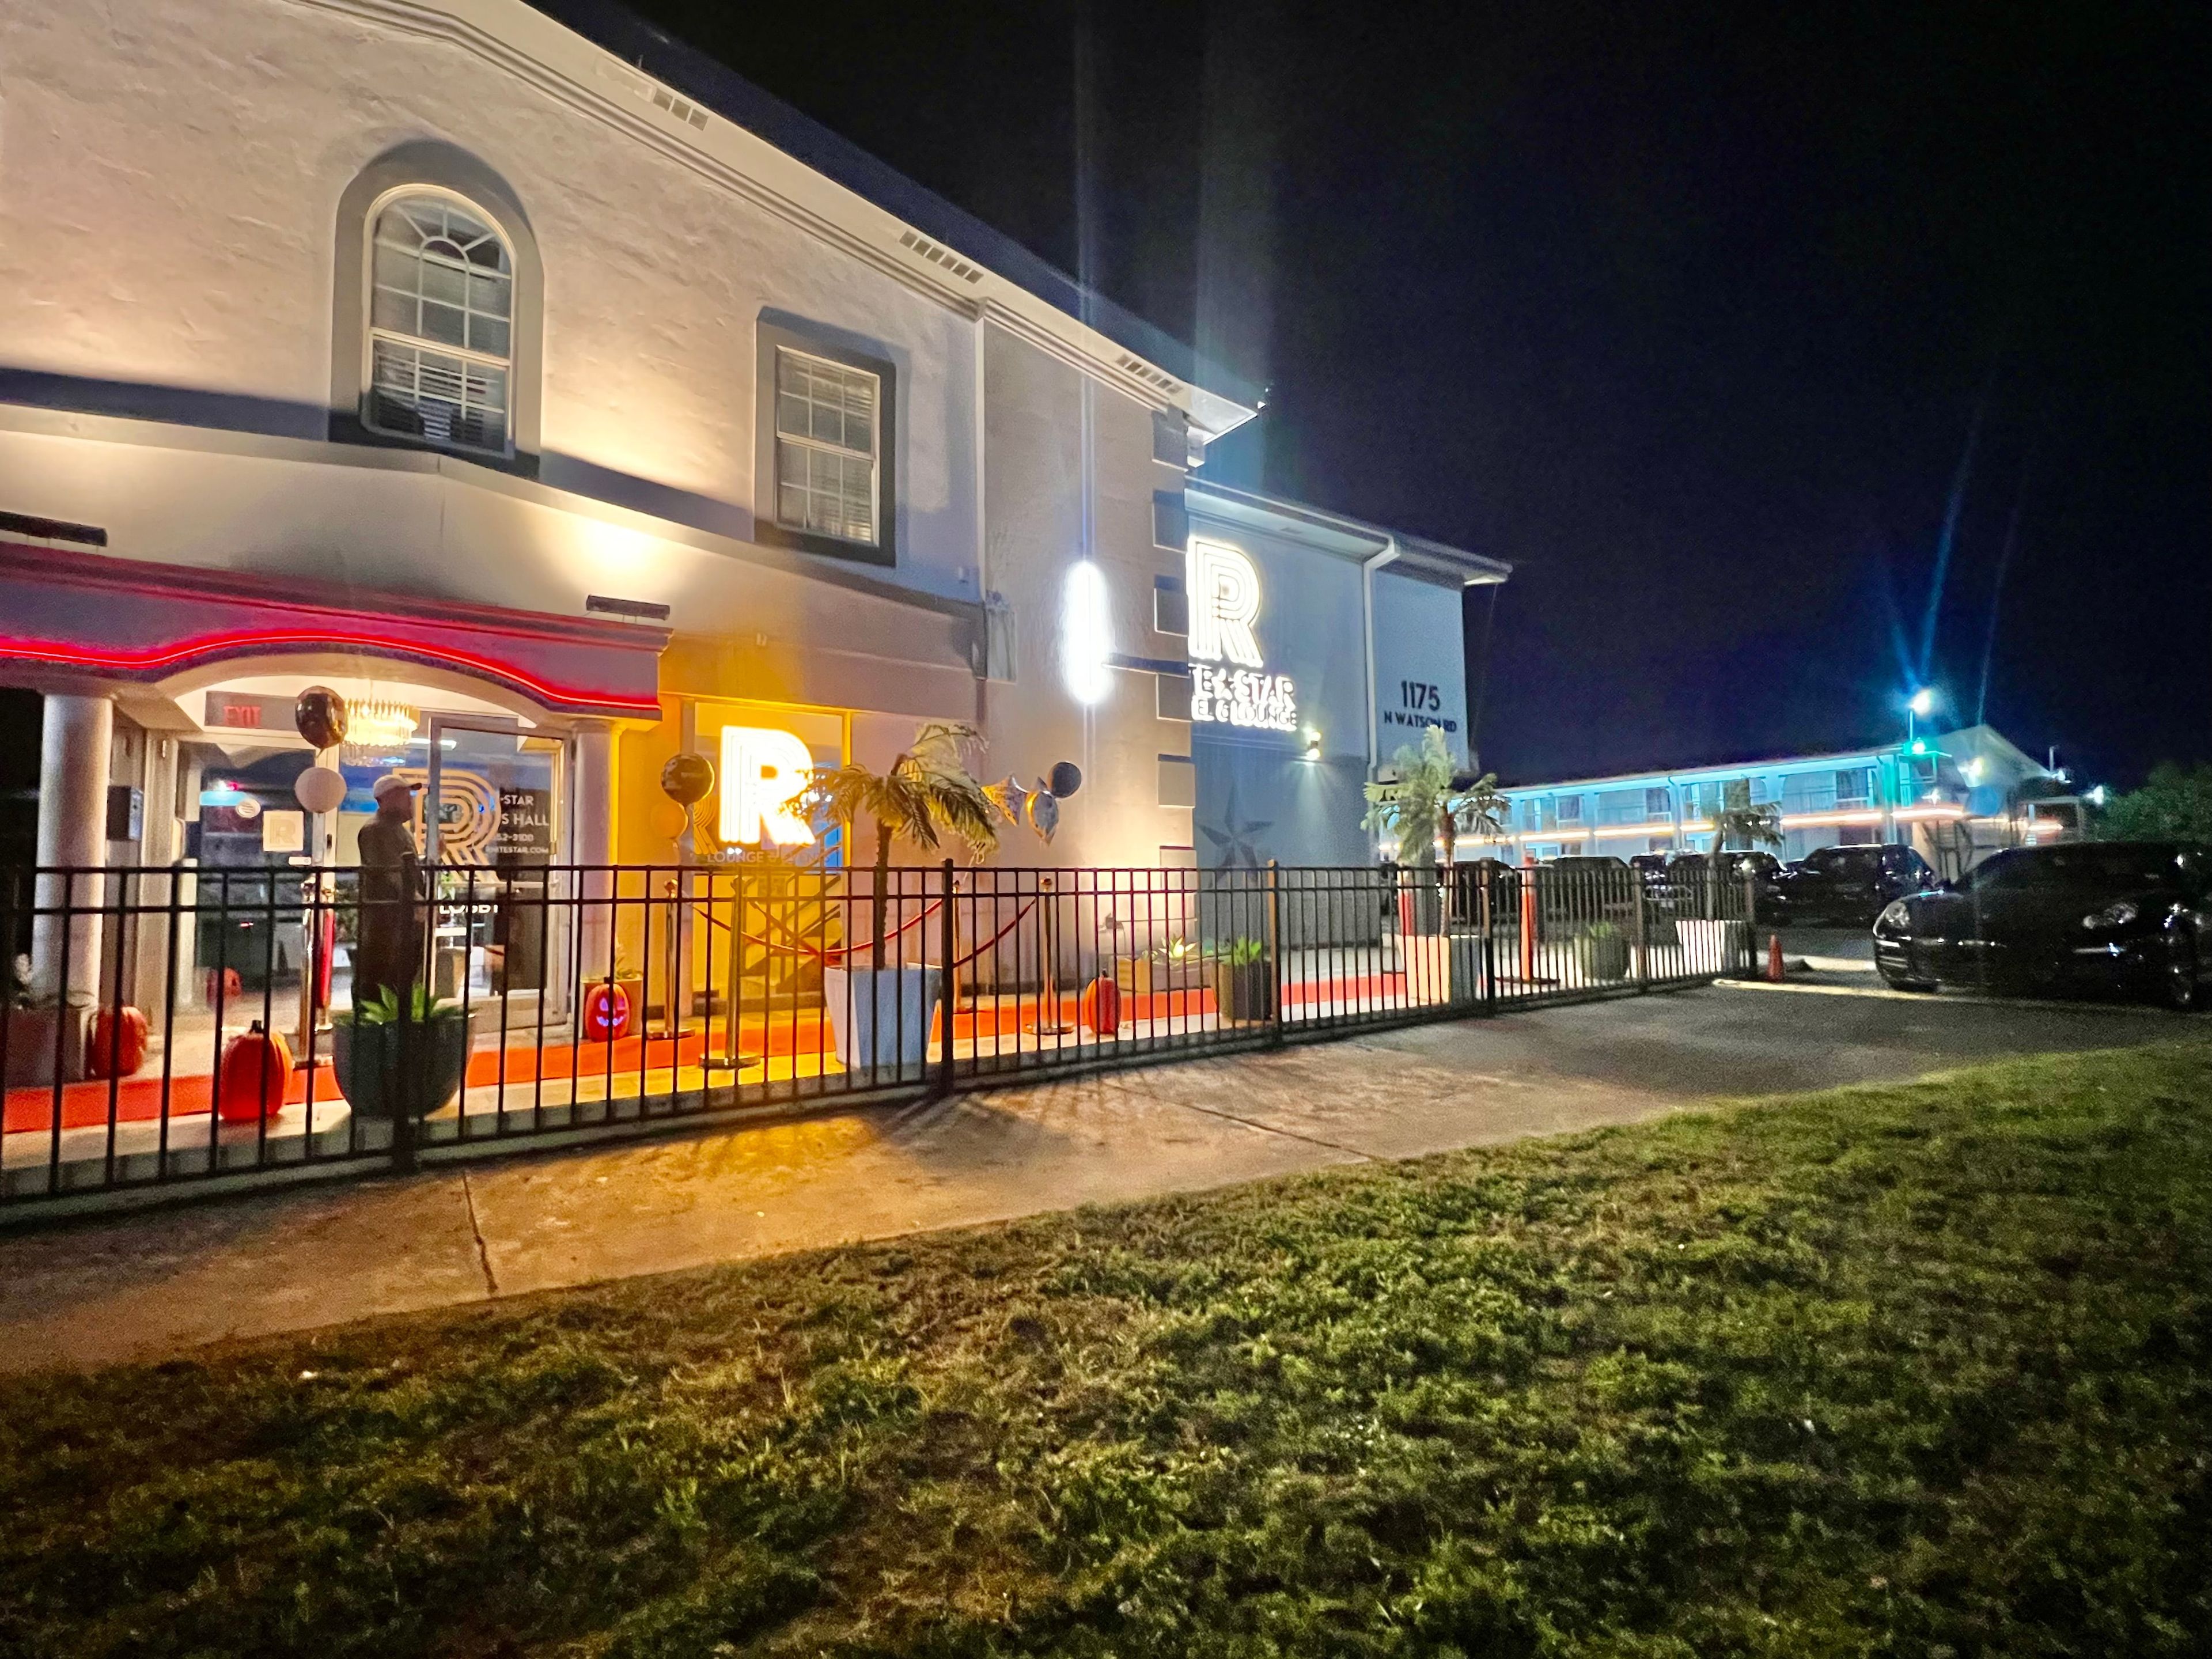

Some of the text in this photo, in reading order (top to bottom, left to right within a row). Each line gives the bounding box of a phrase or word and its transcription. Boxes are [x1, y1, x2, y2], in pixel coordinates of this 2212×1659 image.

[1186, 536, 1263, 668] R
[1401, 680, 1441, 711] 1175
[223, 706, 262, 728] EXIT
[1384, 711, 1457, 733] N WATSON RD
[719, 725, 816, 845] R
[513, 813, 550, 827] HALL
[707, 851, 764, 863] LOUNGE
